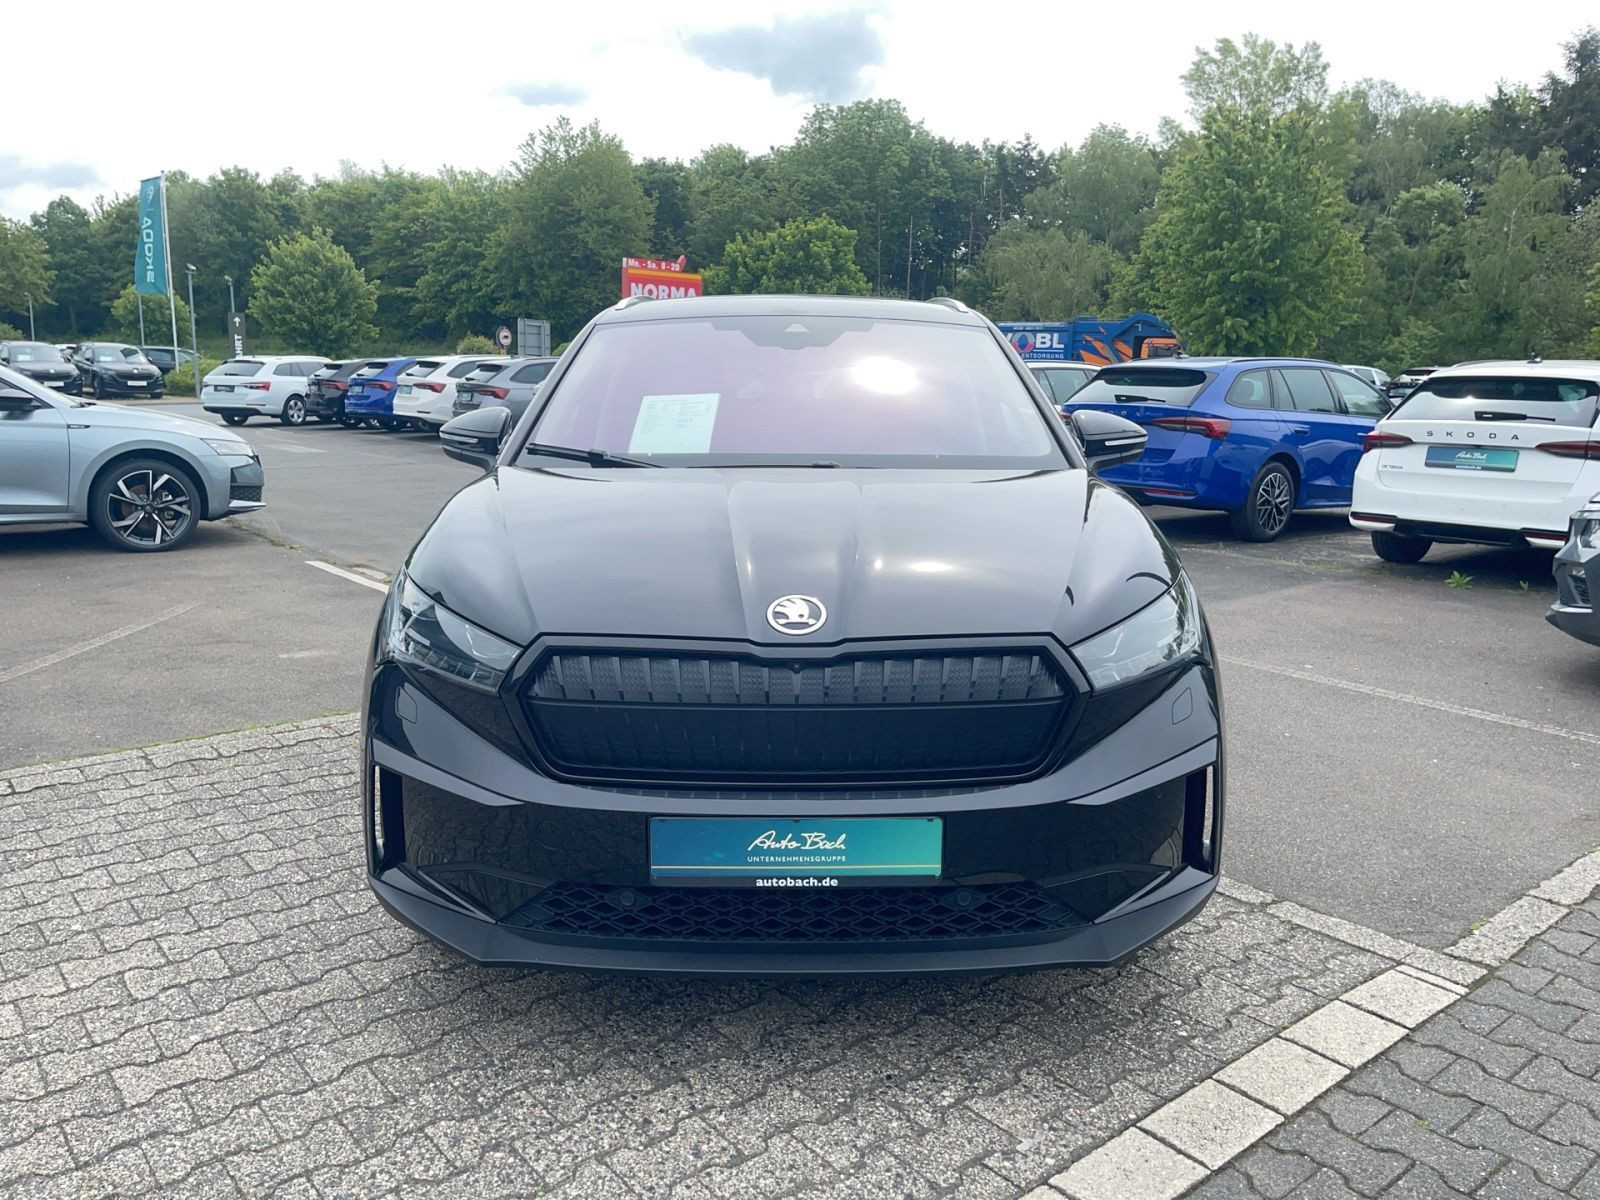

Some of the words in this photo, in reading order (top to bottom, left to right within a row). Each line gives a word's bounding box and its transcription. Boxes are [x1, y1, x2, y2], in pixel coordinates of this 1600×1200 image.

[630, 282, 697, 300] NORMA
[1426, 430, 1519, 441] SKODA
[747, 830, 801, 851] Auto
[800, 832, 847, 850] Bach
[756, 876, 838, 887] autobach.de
